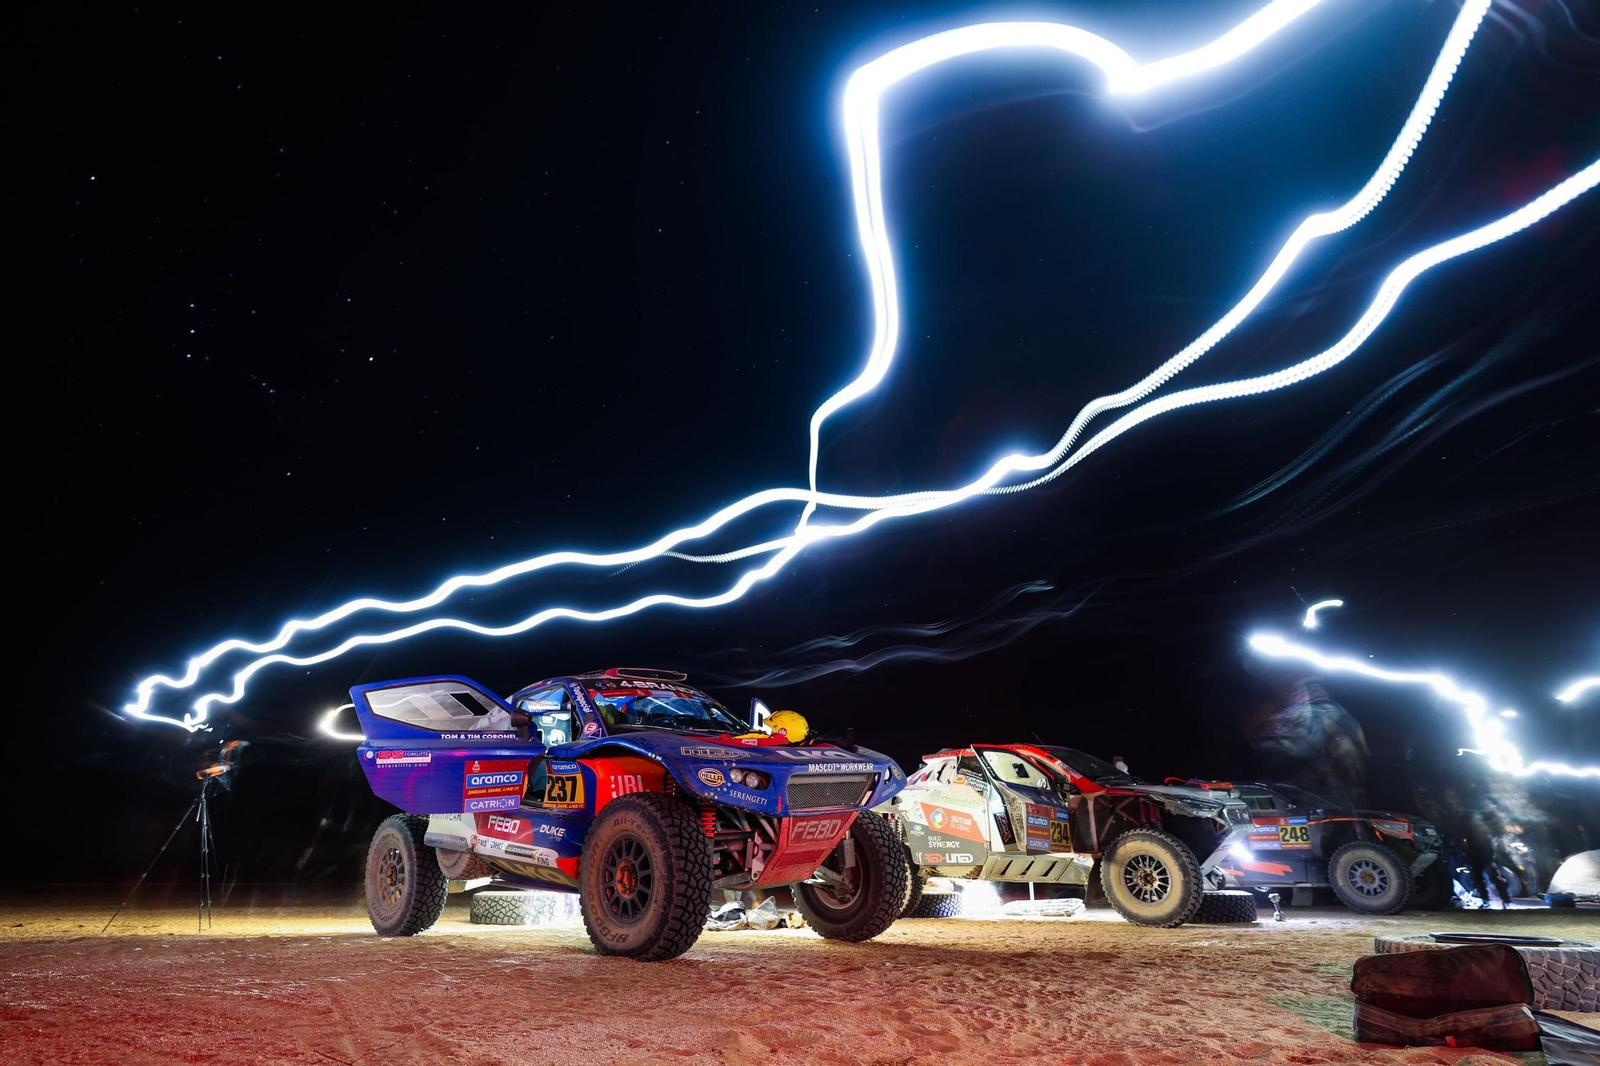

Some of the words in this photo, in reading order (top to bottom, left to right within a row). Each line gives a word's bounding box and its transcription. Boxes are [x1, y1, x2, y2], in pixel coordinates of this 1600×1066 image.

[378, 750, 404, 759] BS
[840, 763, 874, 771] WORKWEAR
[471, 774, 518, 785] aramco
[701, 773, 723, 781] HELLA
[547, 775, 578, 802] 237
[729, 789, 768, 806] SERENGETI
[941, 795, 981, 809] mandala
[951, 815, 973, 826] SUTOR
[1028, 817, 1048, 826] aramco
[539, 824, 566, 837] DUKE
[949, 823, 971, 833] GLOBAL
[1050, 821, 1070, 844] 234
[1280, 826, 1310, 842] 248
